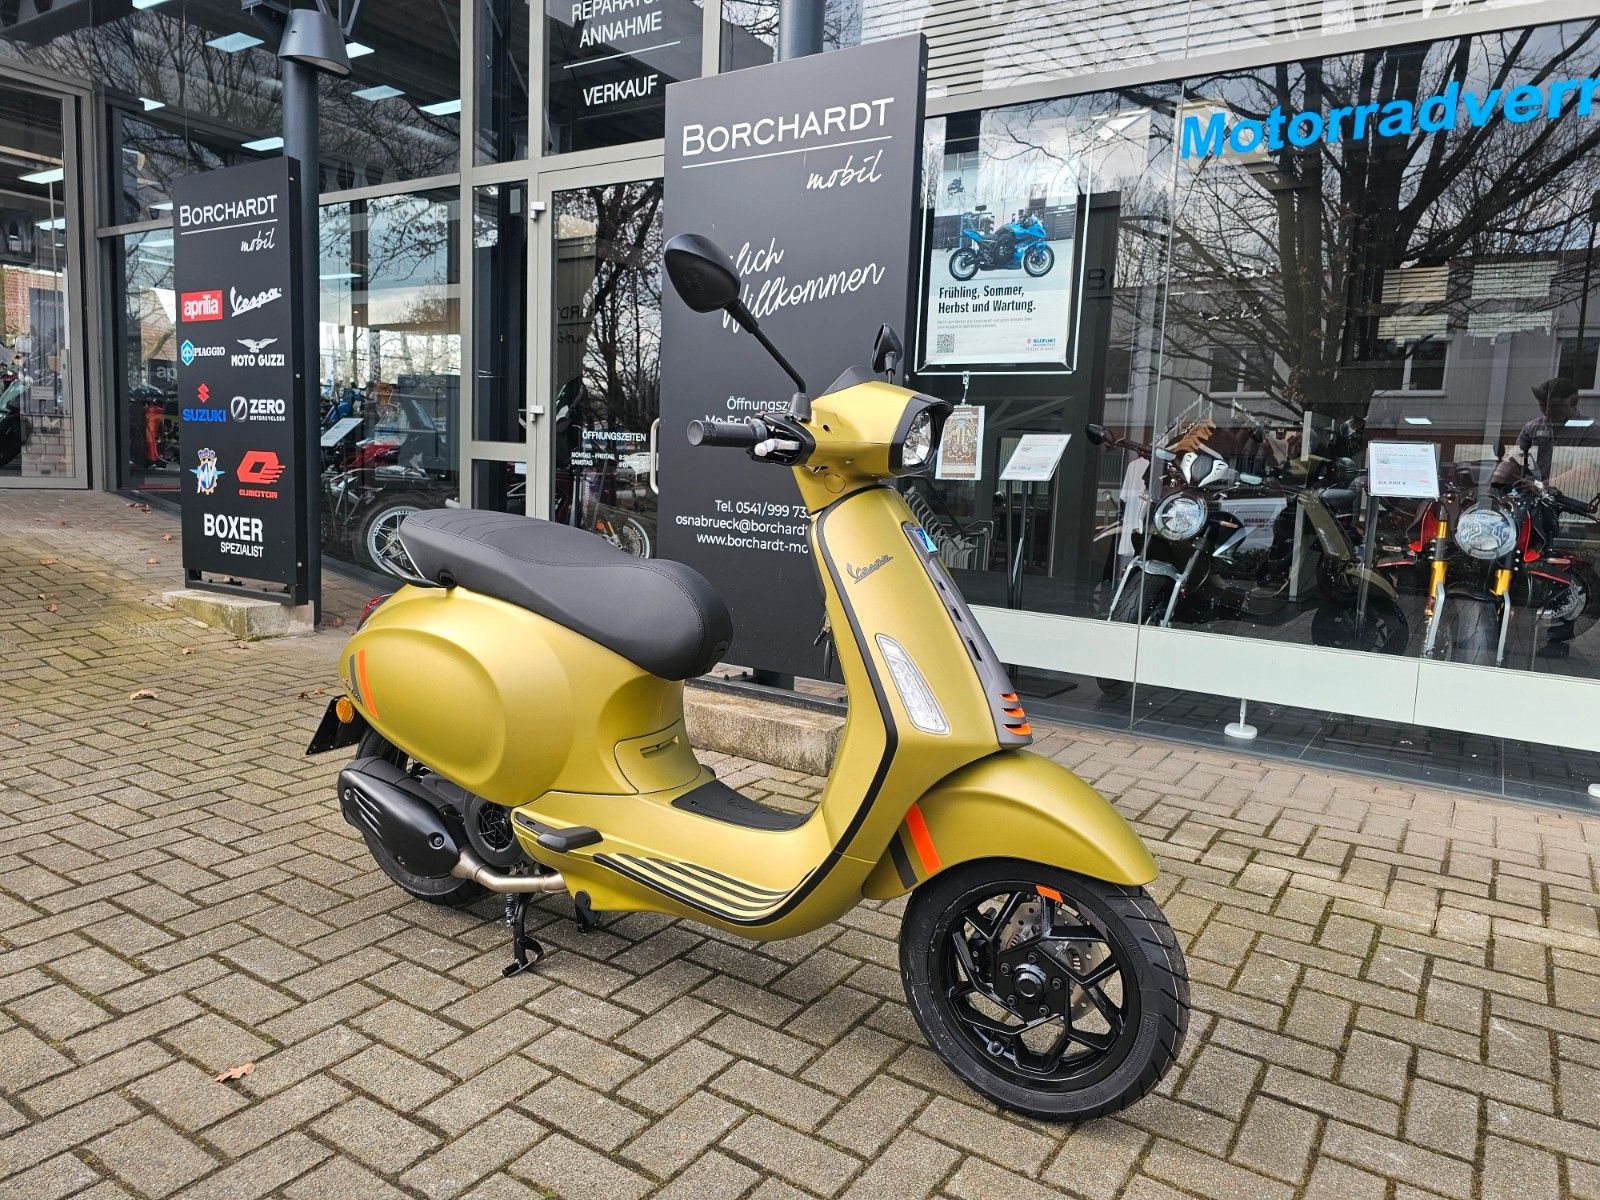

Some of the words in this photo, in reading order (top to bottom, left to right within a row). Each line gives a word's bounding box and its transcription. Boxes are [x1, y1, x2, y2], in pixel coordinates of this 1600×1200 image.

[580, 11, 662, 48] ANNAHME
[583, 74, 658, 106] VERKAUF
[682, 97, 894, 156] BORCHARDT
[806, 149, 883, 189] mobil
[179, 195, 278, 227] BORCHARDT
[240, 228, 275, 252] mobil
[730, 237, 785, 277] lich
[230, 286, 283, 317] Vespa
[939, 286, 980, 300] Frühling,
[983, 285, 1024, 297] Sommer,
[184, 294, 219, 319] aprilia
[938, 302, 969, 314] Herbst
[972, 301, 990, 312] und
[993, 300, 1036, 313] Wartung.
[194, 347, 226, 356] PIAGGIO
[231, 354, 255, 367] MOTO
[257, 354, 284, 367] GUZZI
[182, 409, 227, 422] SUZUKI
[249, 399, 286, 414] ZERO
[715, 500, 733, 513] Tel.
[736, 502, 790, 516] 0541/999
[792, 506, 811, 518] 73
[203, 513, 264, 542] BOXER
[220, 542, 264, 557] SPEZIALIST
[846, 554, 893, 584] Vespa
